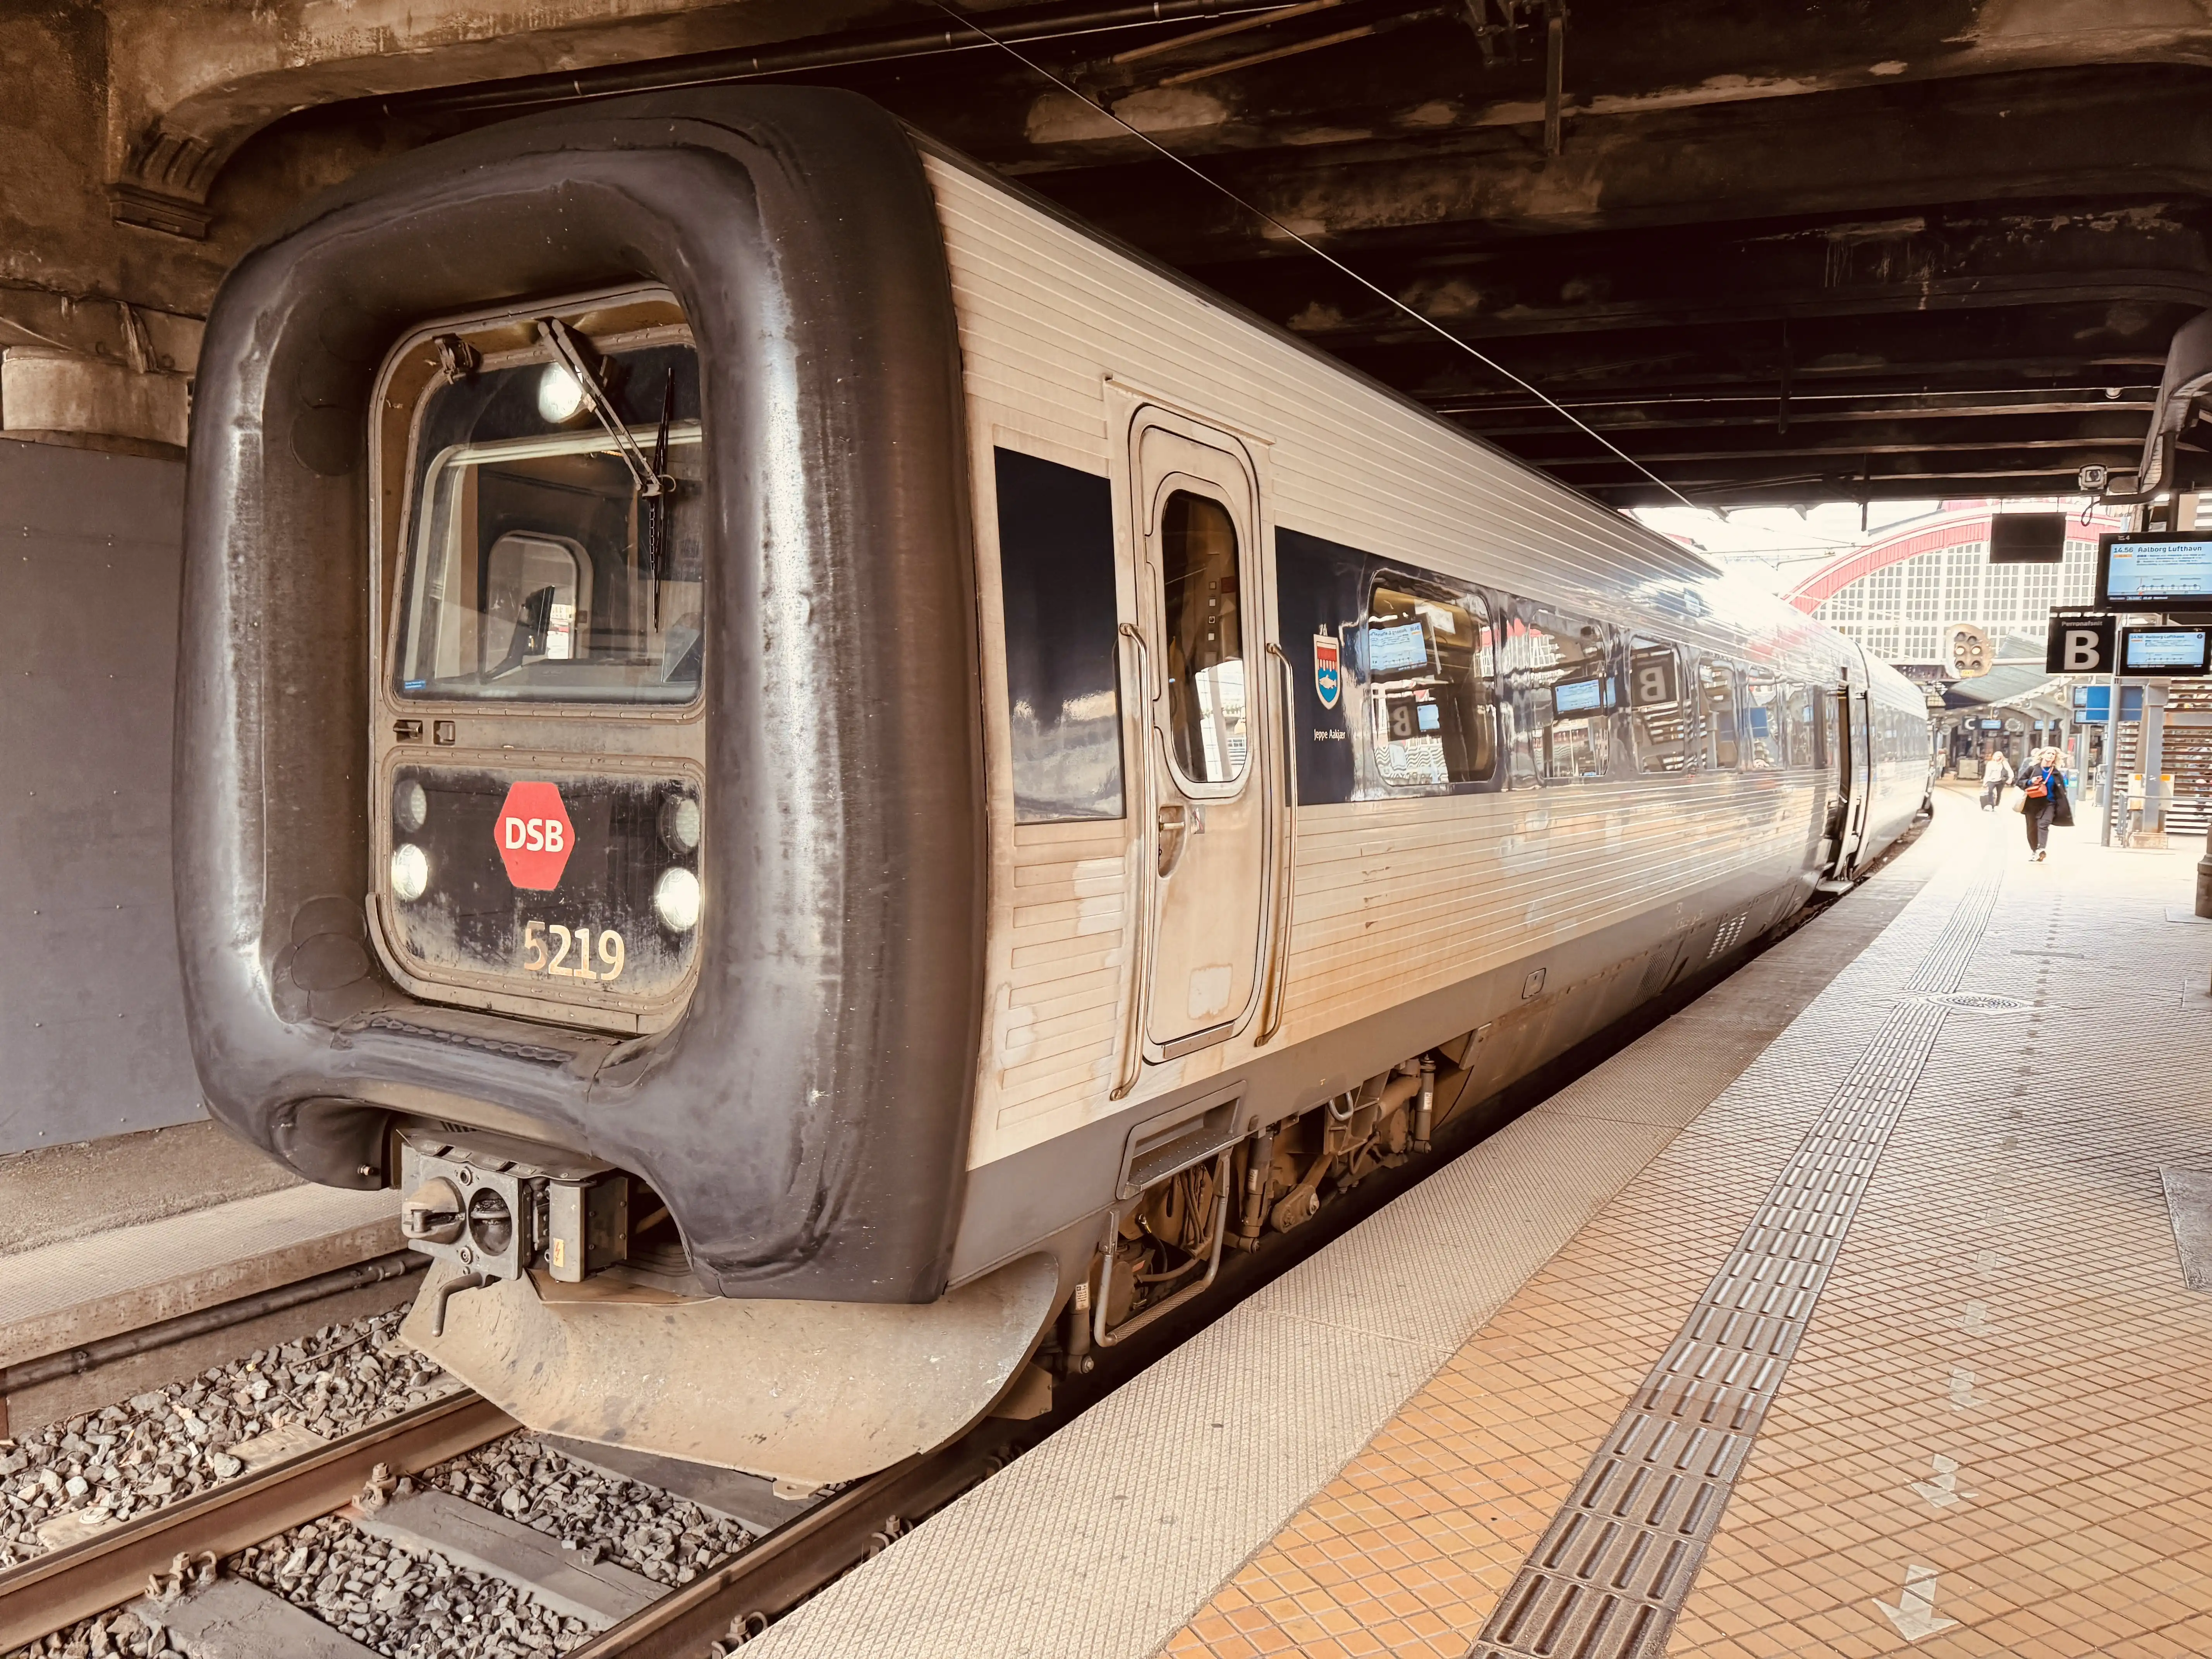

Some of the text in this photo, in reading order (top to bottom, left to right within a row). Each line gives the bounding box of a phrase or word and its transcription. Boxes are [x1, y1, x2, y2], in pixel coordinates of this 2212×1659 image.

[2064, 630, 2100, 670] B
[1314, 729, 1346, 741] Jeppe Aakjær
[1965, 718, 1976, 730] C
[505, 817, 564, 852] DSB
[524, 921, 625, 981] 5219
